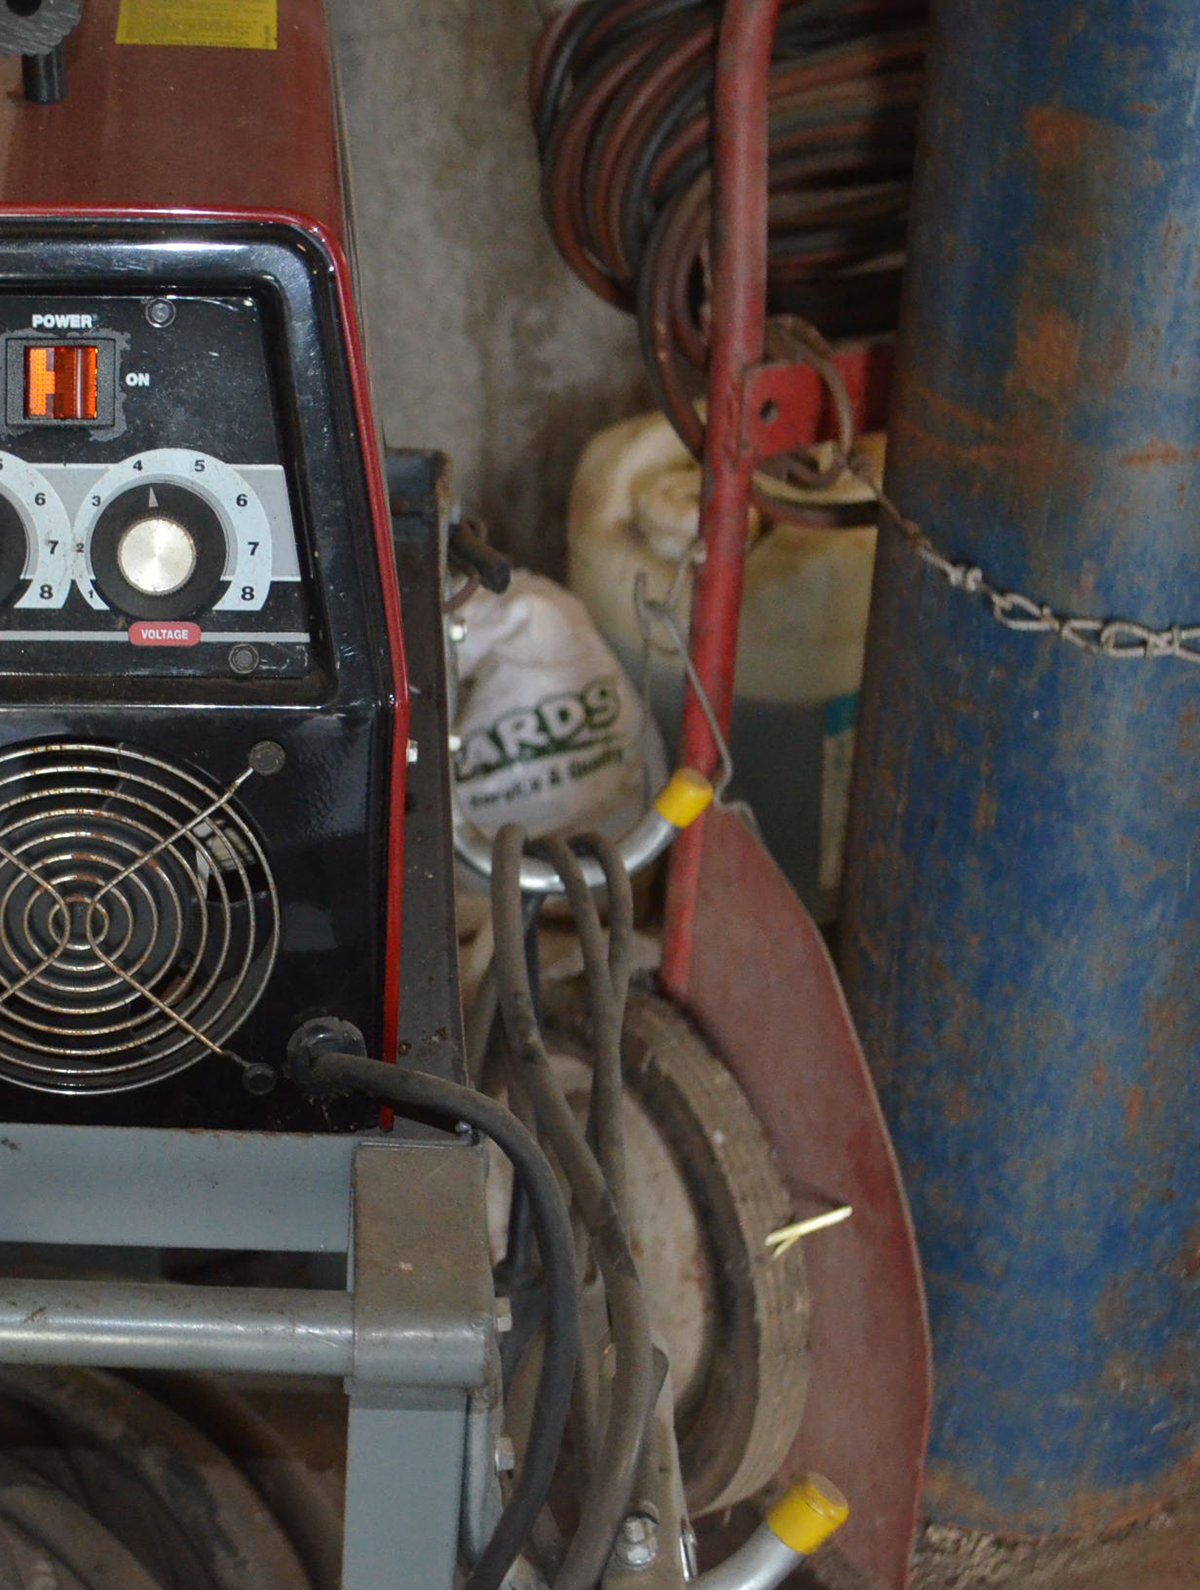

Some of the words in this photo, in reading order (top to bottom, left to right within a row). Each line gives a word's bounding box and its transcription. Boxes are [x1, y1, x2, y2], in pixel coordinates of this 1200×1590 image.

[32, 314, 93, 328] POWER
[125, 373, 150, 387] ON
[133, 459, 143, 471] 4
[194, 459, 205, 472] 5
[34, 492, 46, 506] 6
[92, 495, 101, 507] 3
[236, 493, 248, 507] 6
[47, 540, 59, 554] 7
[76, 543, 84, 553] 2
[247, 541, 259, 556] 7
[39, 584, 53, 600] 8
[88, 589, 94, 599] 1
[240, 585, 255, 601] 8
[141, 629, 189, 640] VOLTAGE
[455, 677, 622, 783] ARDS
